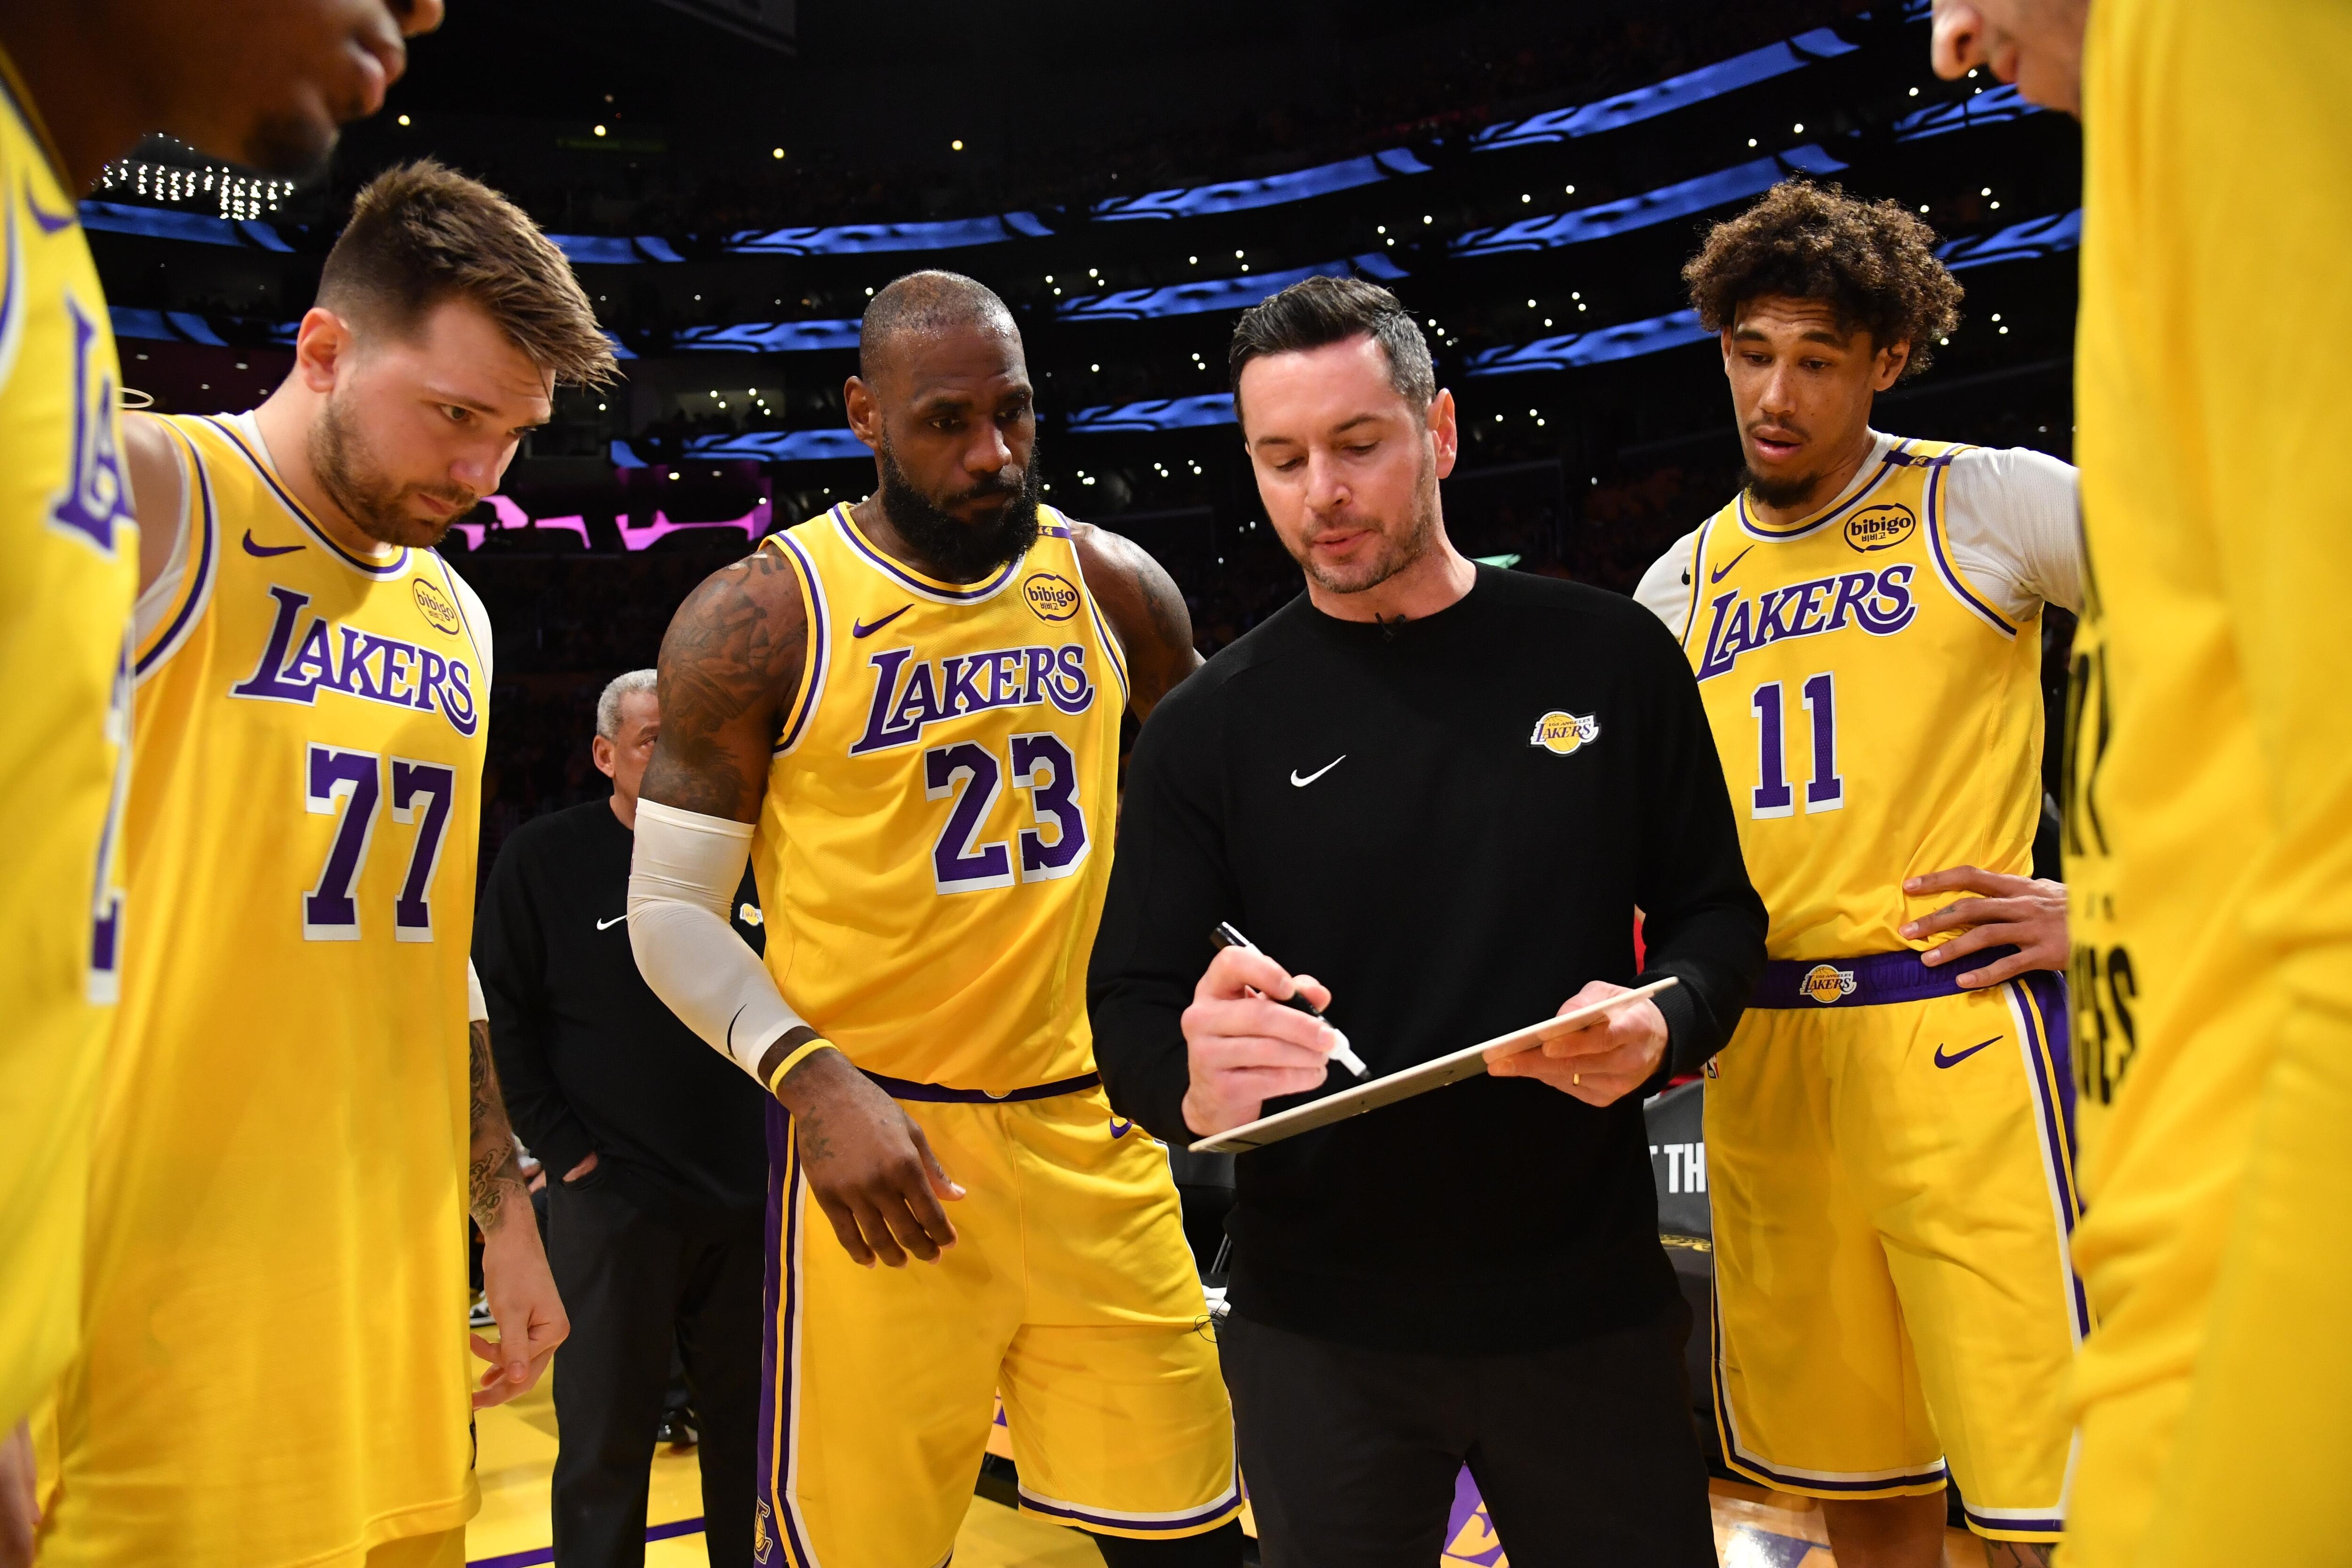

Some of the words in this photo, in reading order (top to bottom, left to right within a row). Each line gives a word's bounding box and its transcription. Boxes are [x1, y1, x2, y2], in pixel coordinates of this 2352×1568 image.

[1851, 517, 1911, 535] bibigo
[1861, 532, 1886, 542] 비비고
[415, 589, 454, 621] bibigo
[1027, 586, 1075, 607] bibigo
[1697, 563, 1919, 684] LAKERS
[228, 583, 478, 738] LAKERS
[847, 644, 1095, 758] LAKERS
[1534, 723, 1595, 742] LAKERS
[1751, 671, 1843, 820] 11
[302, 741, 456, 942] 77
[923, 732, 1091, 895] 23
[1802, 975, 1854, 993] LAKERS
